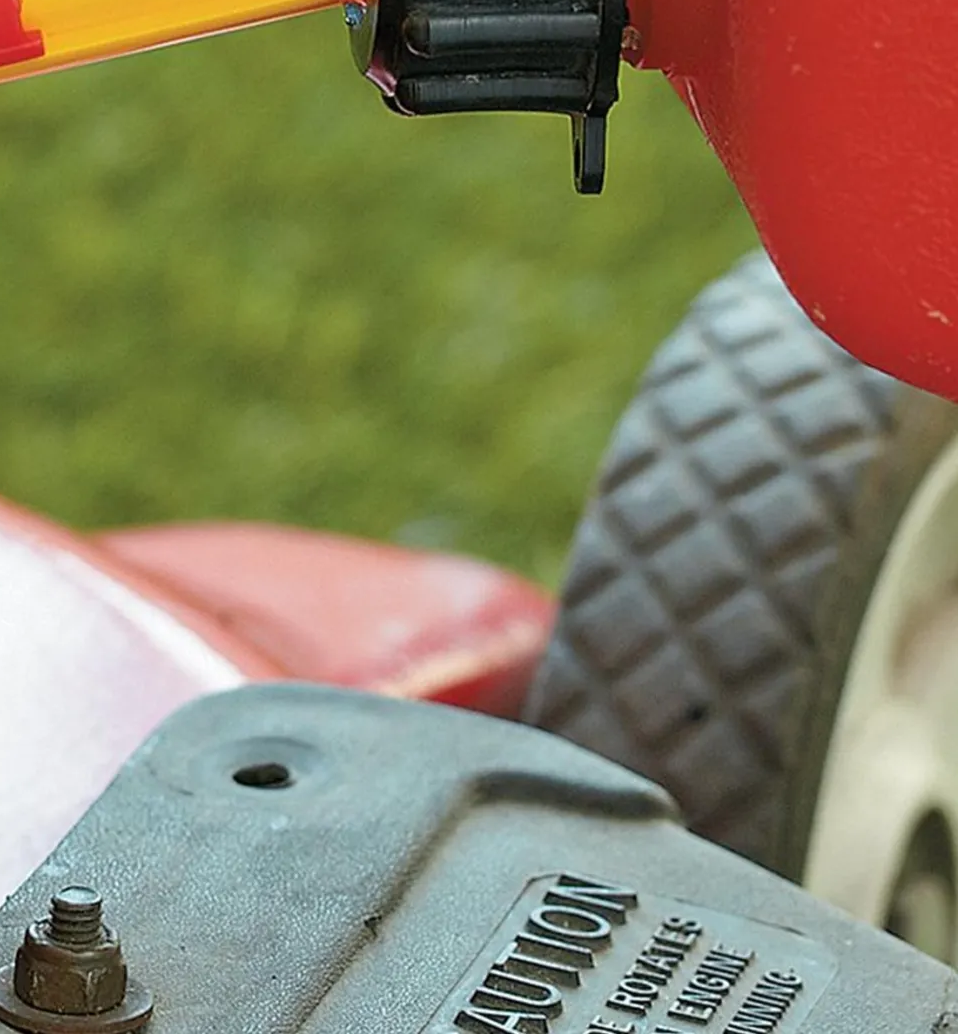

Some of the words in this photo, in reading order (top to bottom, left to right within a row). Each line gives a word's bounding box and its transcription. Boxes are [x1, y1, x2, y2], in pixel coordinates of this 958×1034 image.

[444, 870, 638, 1034] AUTION
[606, 916, 703, 1016] ROTATES
[667, 941, 755, 1025] ENGINE
